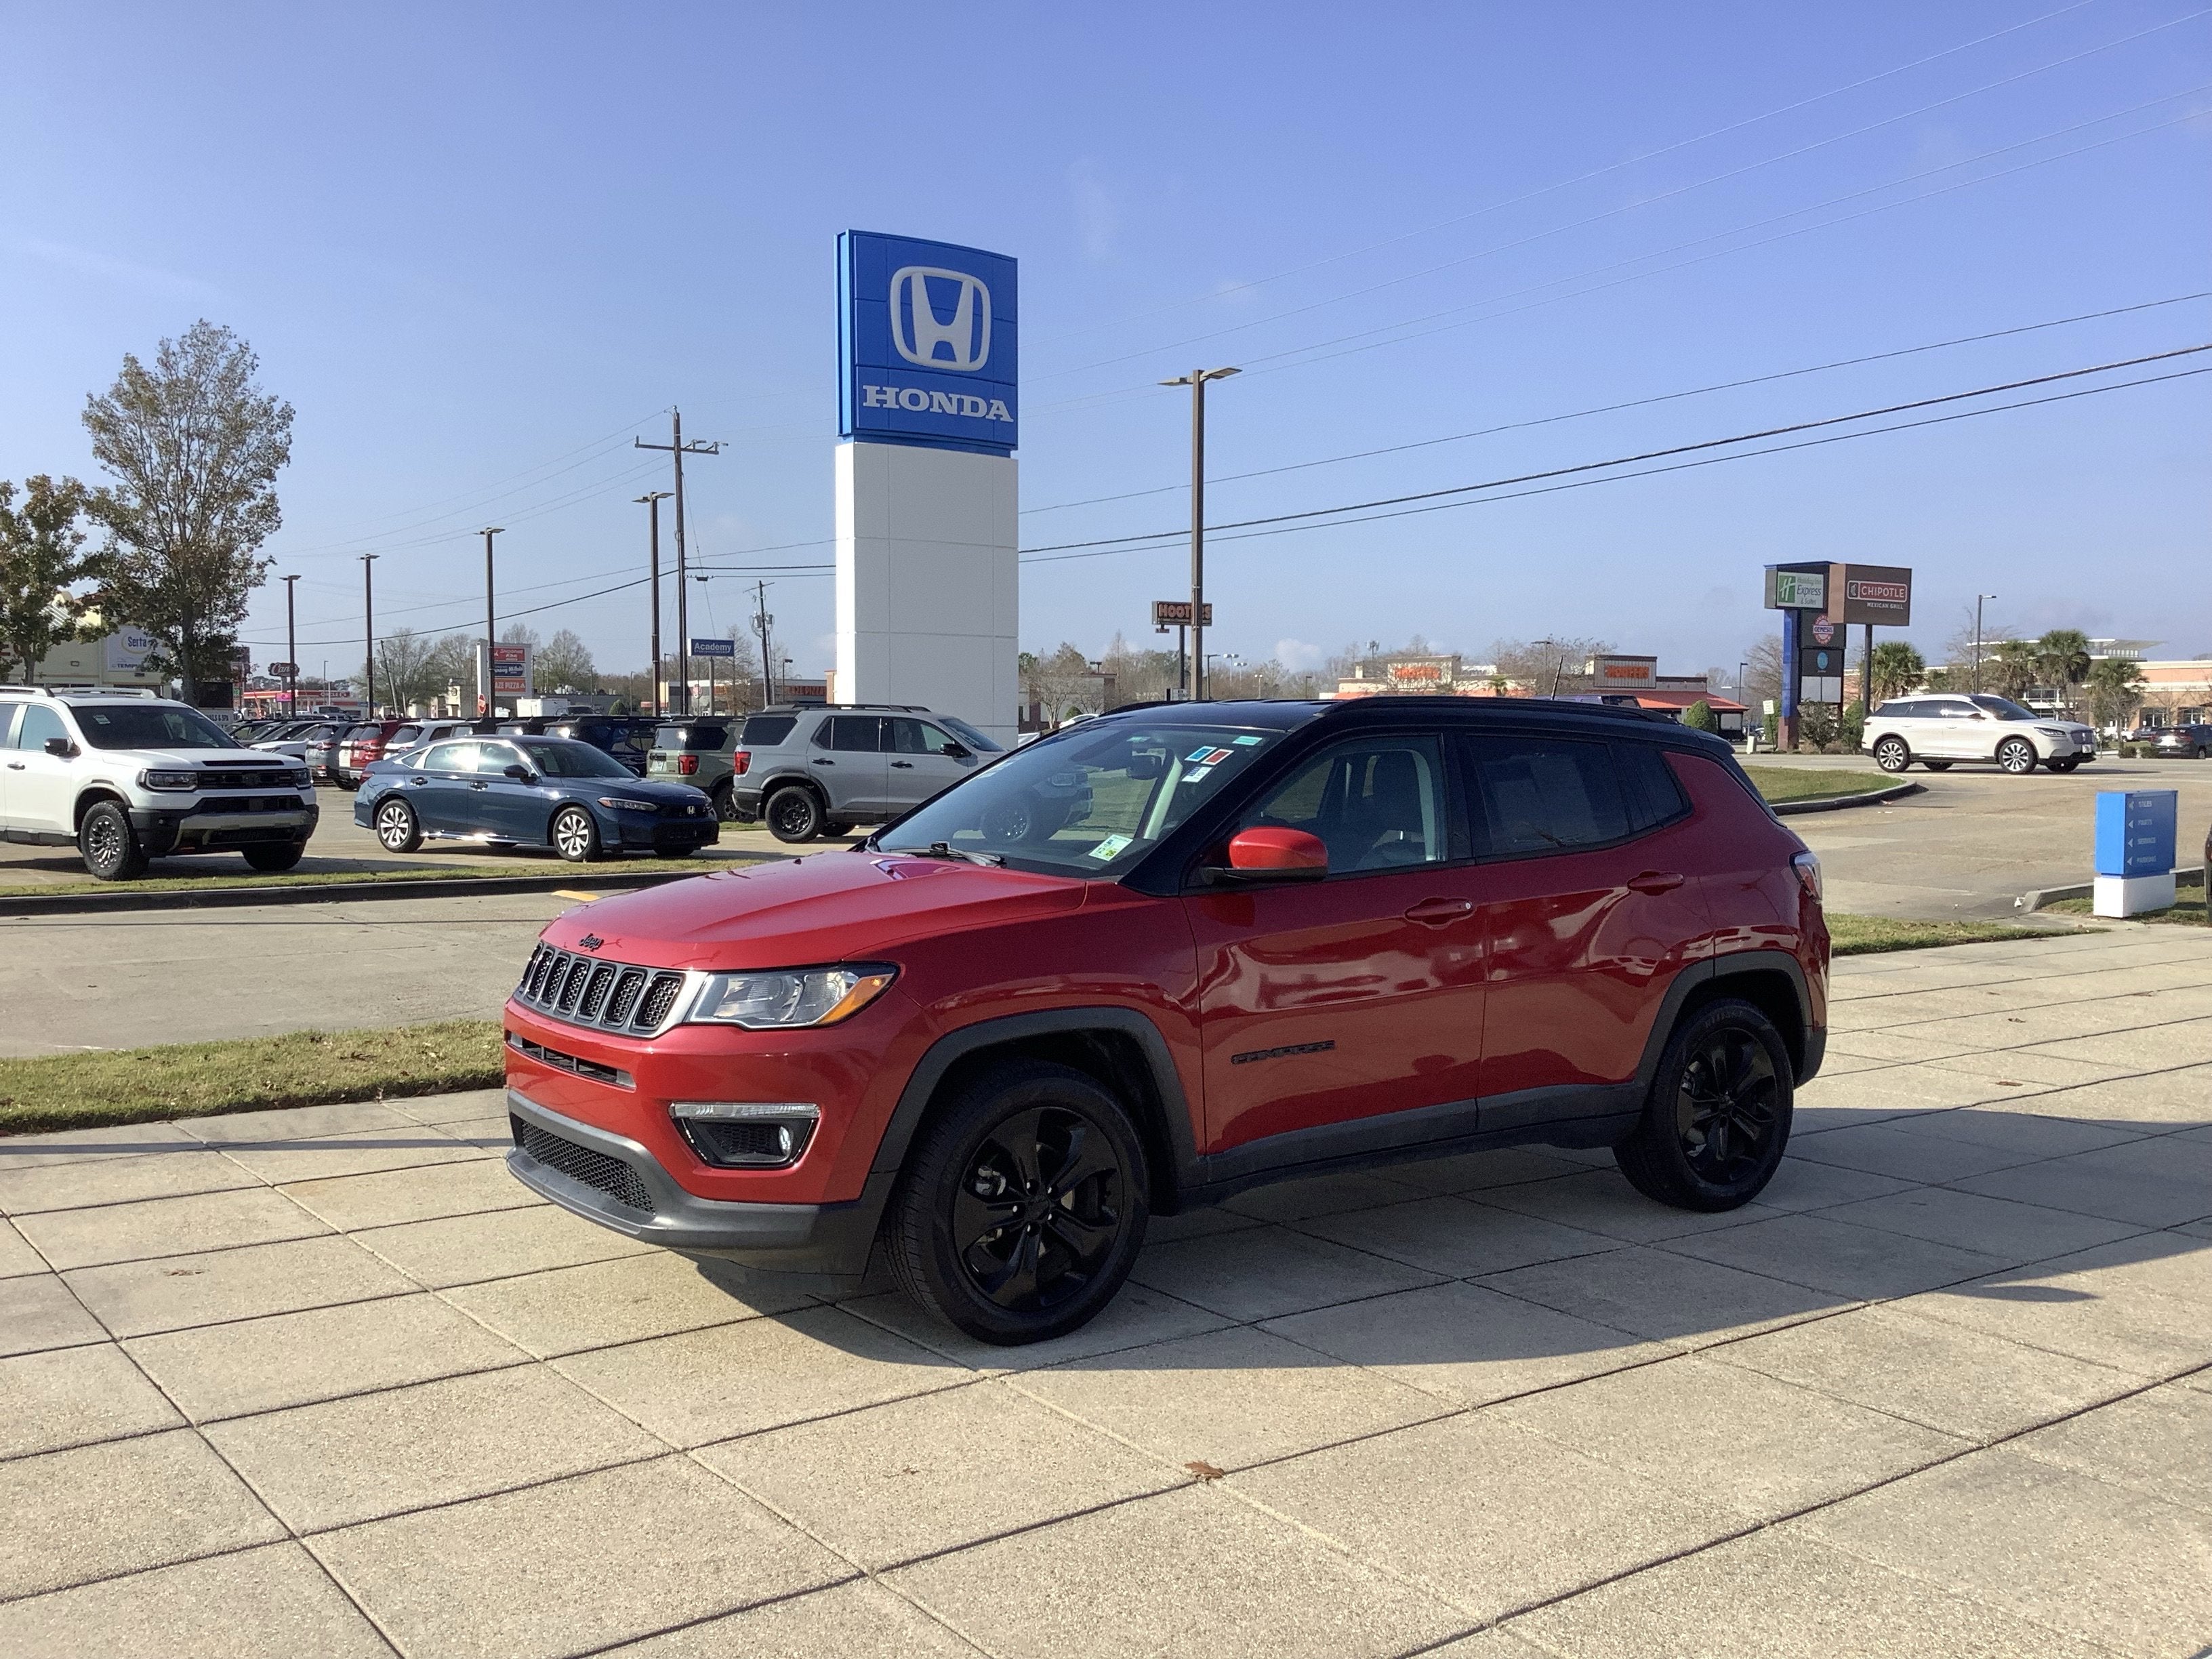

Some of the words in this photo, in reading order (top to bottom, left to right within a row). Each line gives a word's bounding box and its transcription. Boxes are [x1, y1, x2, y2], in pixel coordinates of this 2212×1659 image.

[863, 384, 1014, 422] HONDA
[1797, 584, 1822, 597] Express
[1861, 586, 1905, 598] CHIPOTLE
[127, 636, 147, 647] Serta
[694, 642, 732, 653] Academy
